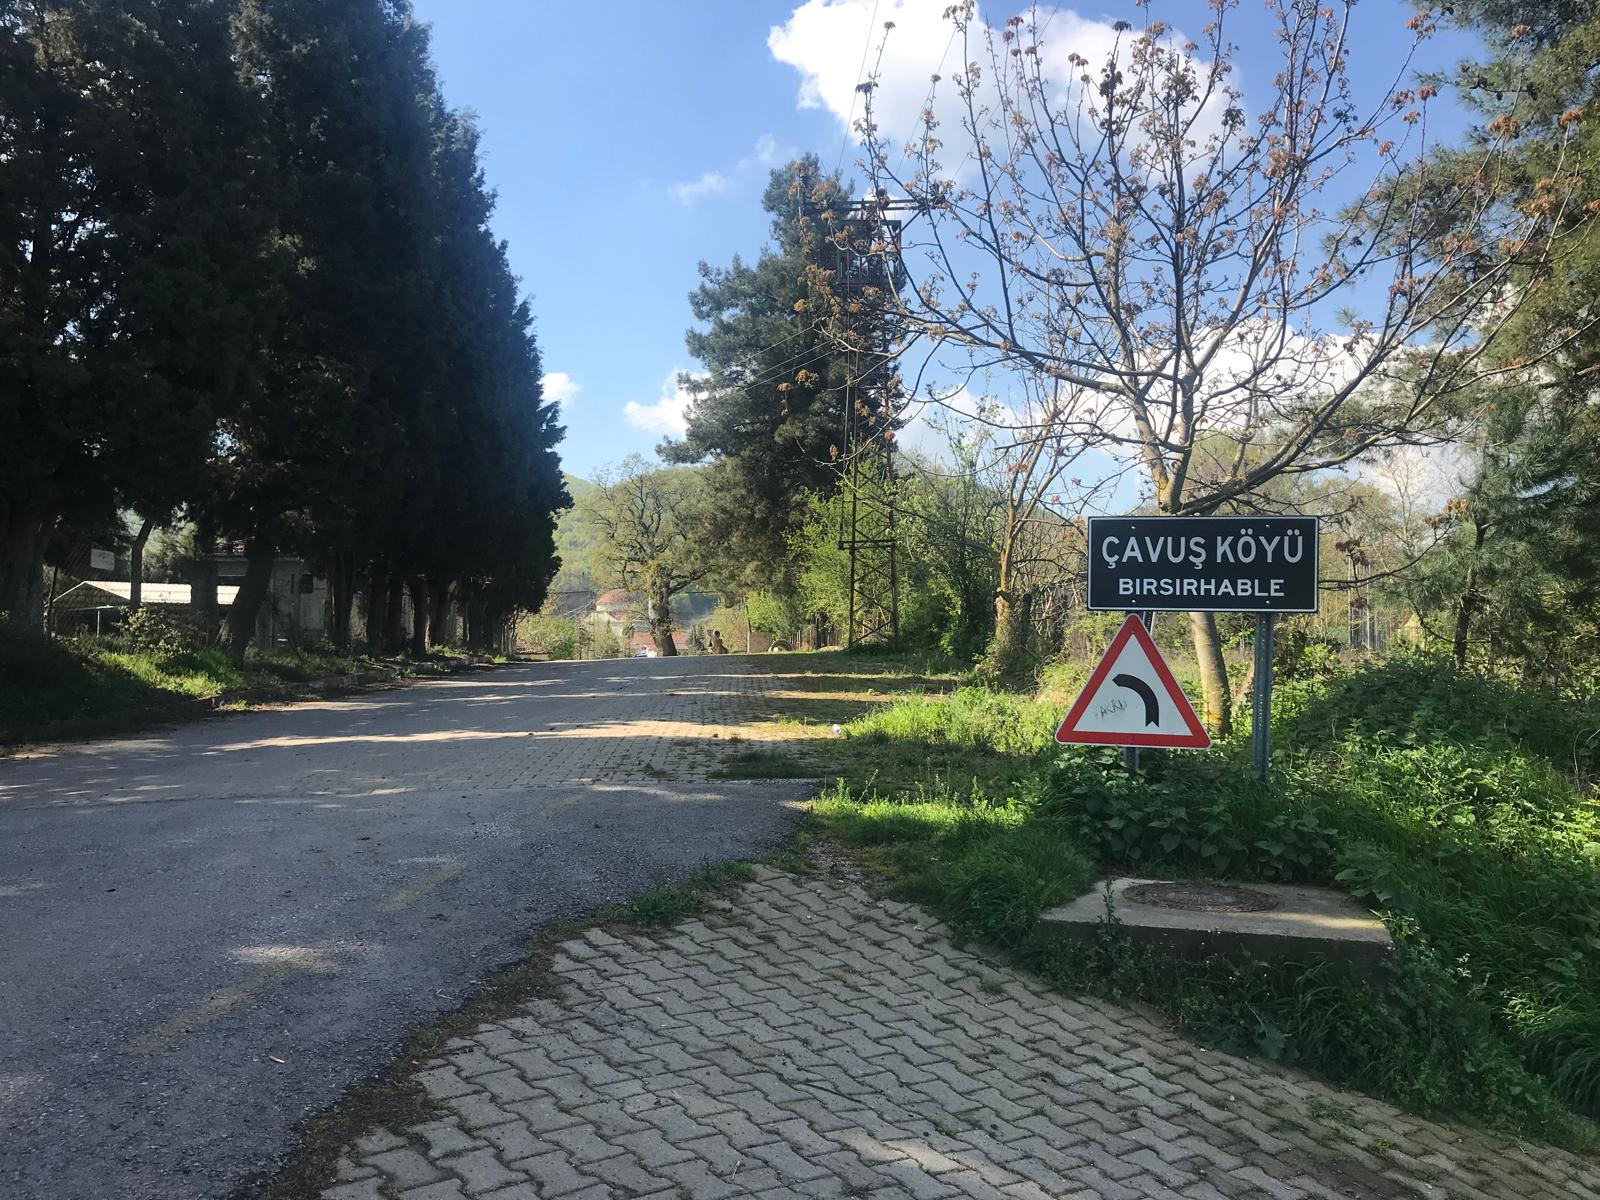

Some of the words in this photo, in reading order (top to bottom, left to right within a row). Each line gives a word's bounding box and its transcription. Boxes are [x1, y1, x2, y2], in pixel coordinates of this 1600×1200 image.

[1102, 535, 1207, 570] ÇAVUŞ
[1216, 528, 1303, 563] KÖYÜ
[1118, 578, 1285, 597] BIRSIRHABLE
